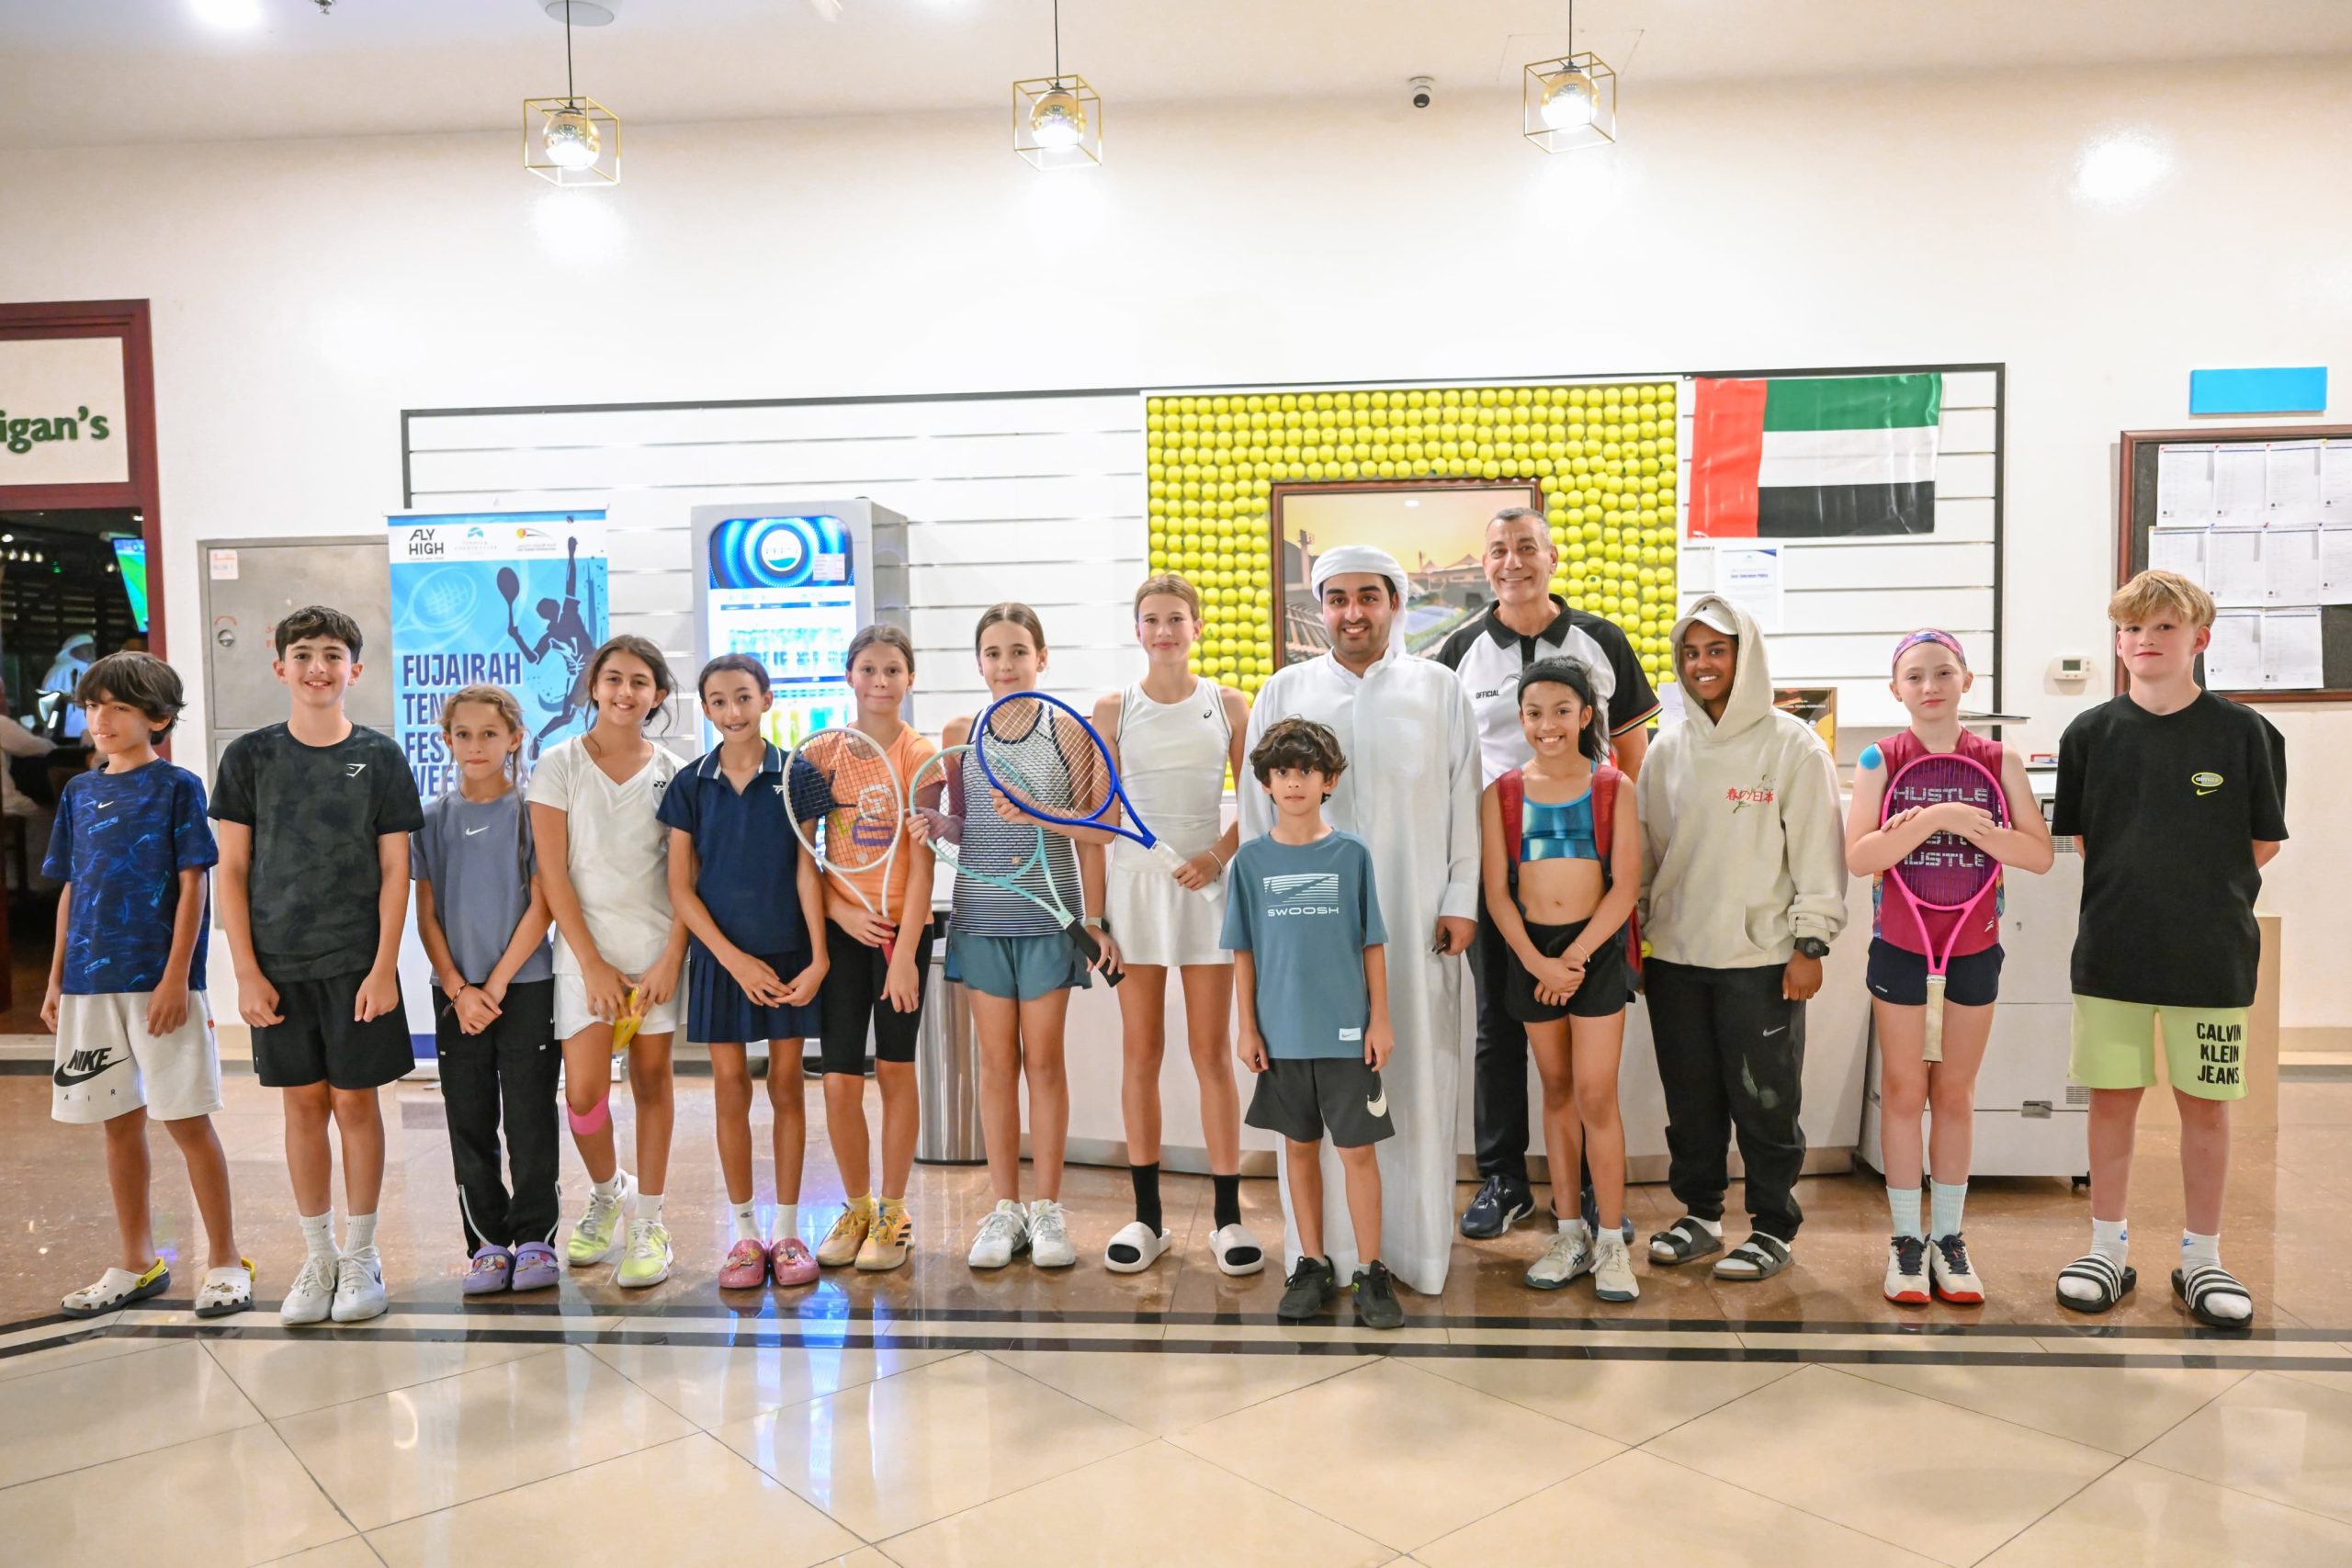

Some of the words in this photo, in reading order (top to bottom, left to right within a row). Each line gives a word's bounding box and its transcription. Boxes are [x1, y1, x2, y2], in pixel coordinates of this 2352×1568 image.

[410, 529, 435, 541] FLY
[409, 542, 444, 555] HIGH
[403, 652, 522, 687] FUJAIRAH
[1476, 690, 1499, 699] OFFICIAL
[402, 693, 456, 725] TEN
[405, 732, 449, 763] FES
[1726, 787, 1773, 804] 春の日本
[1894, 786, 1987, 802] HUSTLE
[1268, 907, 1339, 917] SWOOSH
[2197, 1022, 2241, 1042] CALVIN
[67, 1047, 112, 1072] NIKE
[2200, 1043, 2239, 1063] KLEIN
[2197, 1065, 2239, 1085] JEANS
